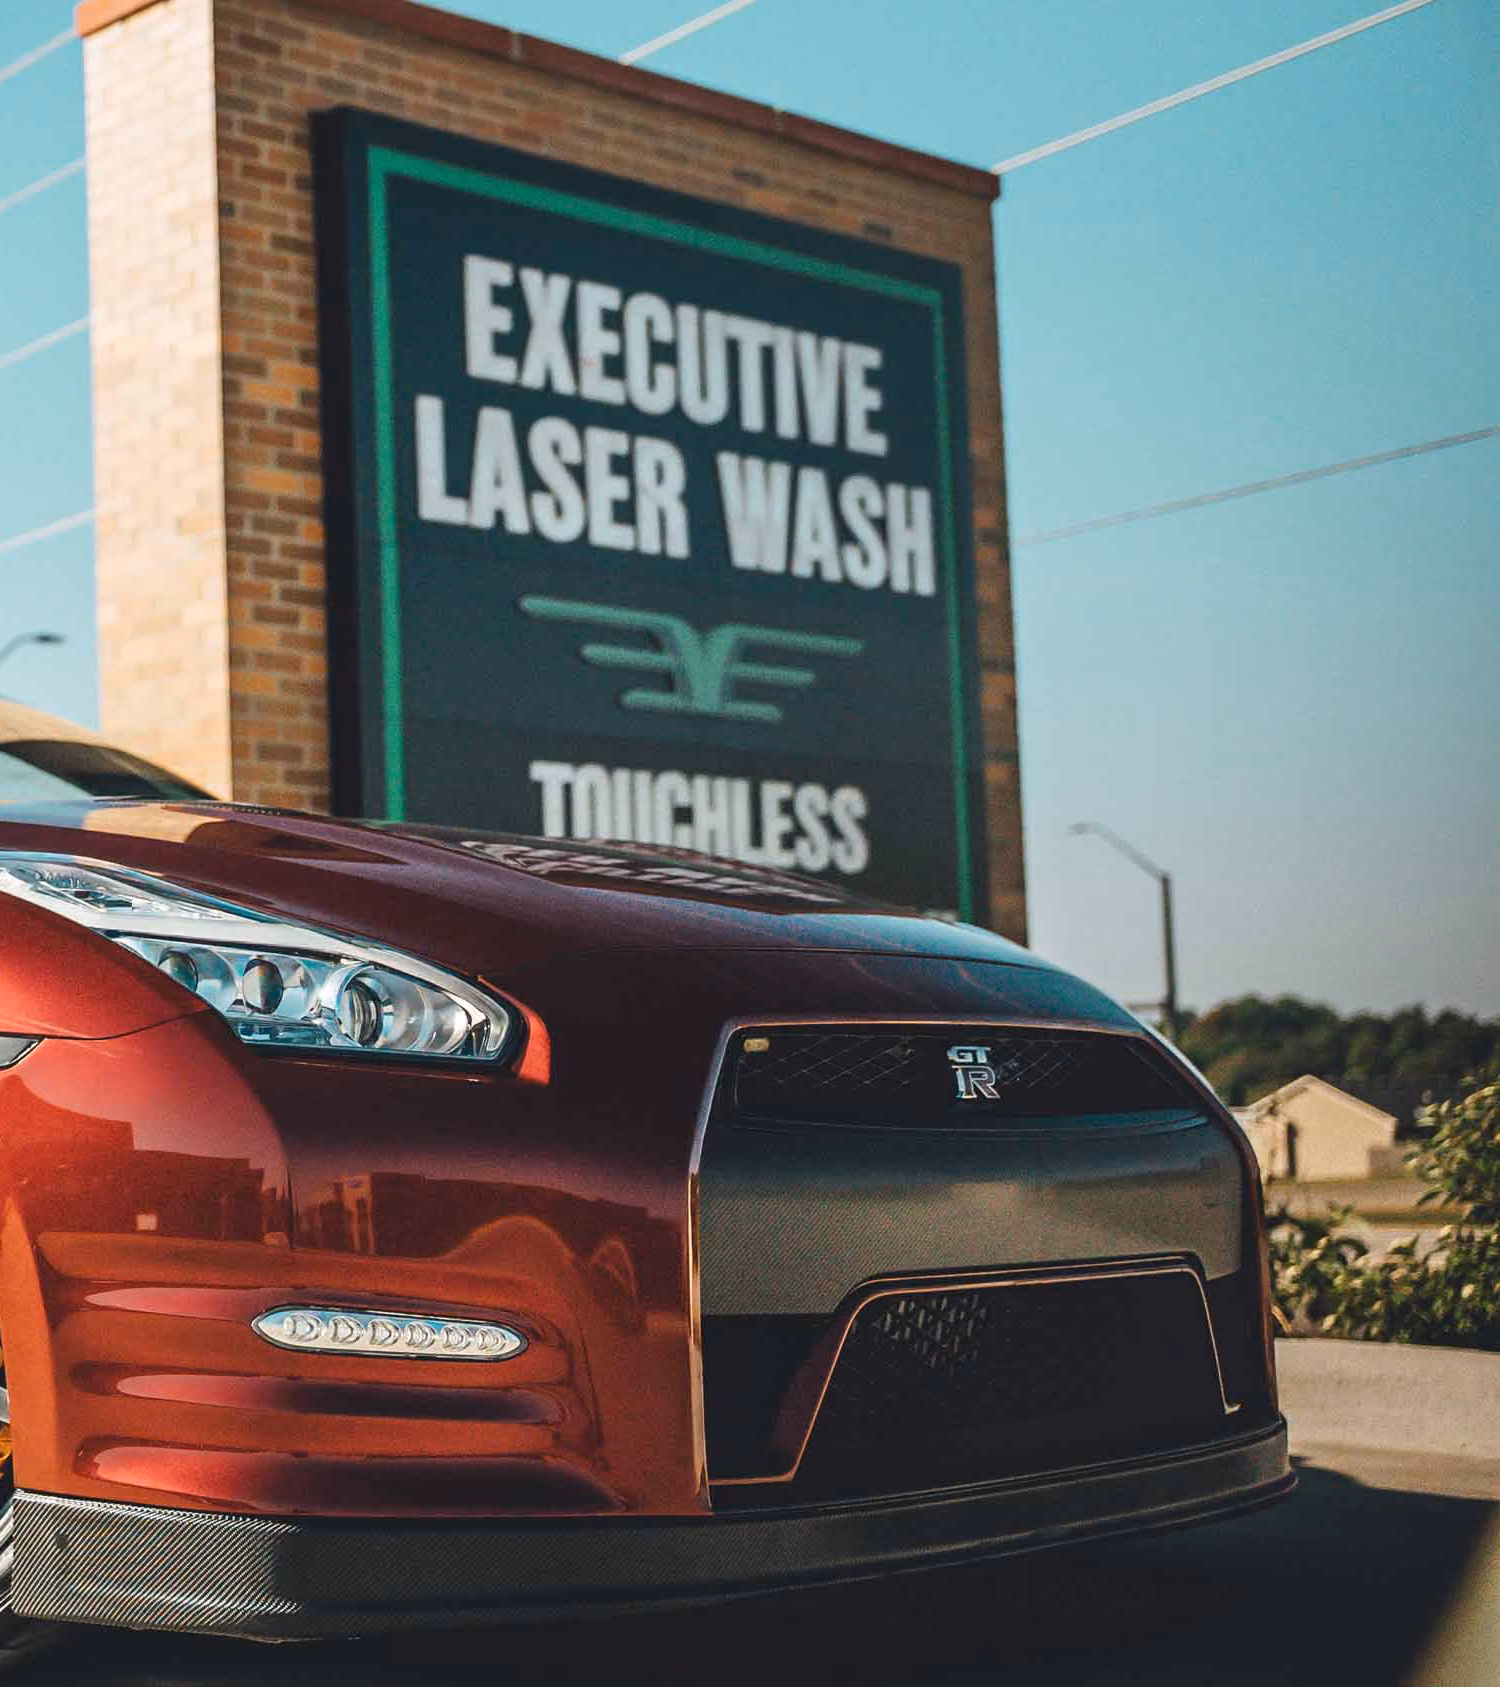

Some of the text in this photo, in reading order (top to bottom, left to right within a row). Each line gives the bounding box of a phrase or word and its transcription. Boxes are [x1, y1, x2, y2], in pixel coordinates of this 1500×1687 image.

[462, 253, 888, 457] EXECUTIVE
[414, 393, 936, 596] LASER WASH
[529, 760, 869, 875] TOUCHLESS
[947, 1046, 991, 1064] GT
[951, 1065, 1000, 1098] R
